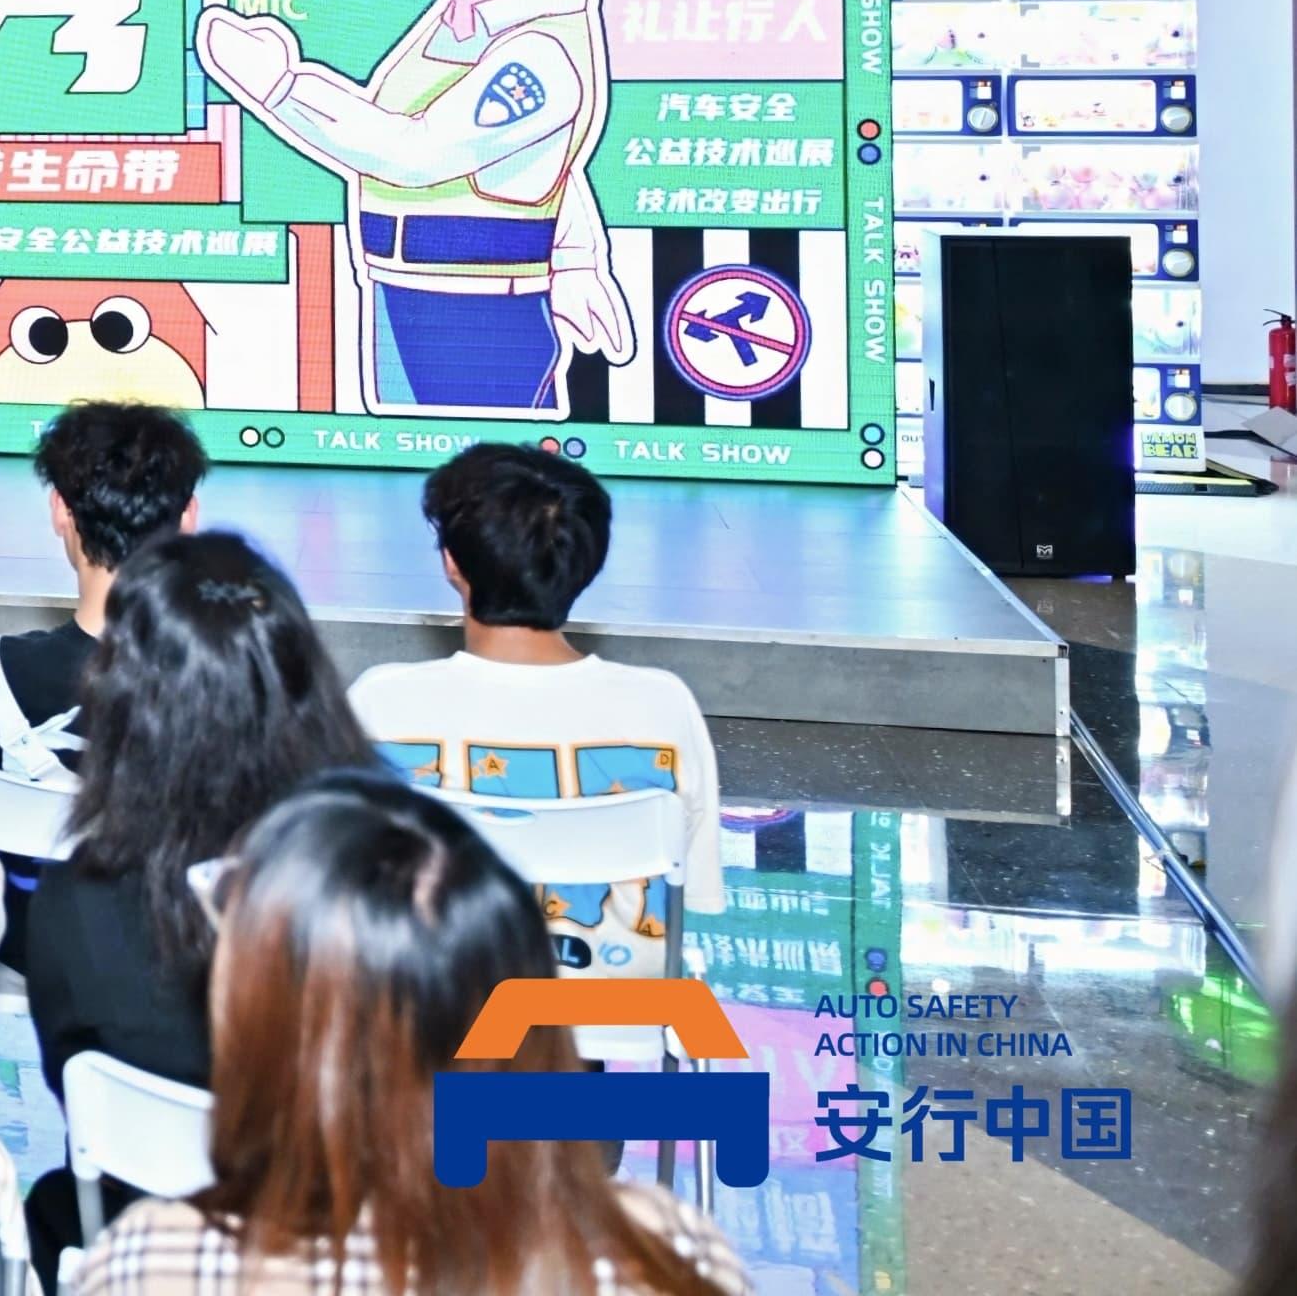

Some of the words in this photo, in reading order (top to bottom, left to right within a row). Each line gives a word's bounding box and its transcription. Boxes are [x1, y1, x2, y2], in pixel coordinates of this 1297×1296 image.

[622, 0, 828, 43] 礼让行人
[657, 92, 799, 122] 汽车安全
[624, 136, 836, 167] 公益技术巡展
[635, 187, 824, 217] 技术改变出行
[863, 196, 885, 265] TALK
[863, 278, 887, 364] SHOW
[313, 429, 381, 450] TALK
[614, 439, 686, 461] TALK
[701, 442, 793, 465] SHOW
[1141, 431, 1197, 445] DAMON
[1142, 444, 1200, 459] BEAR
